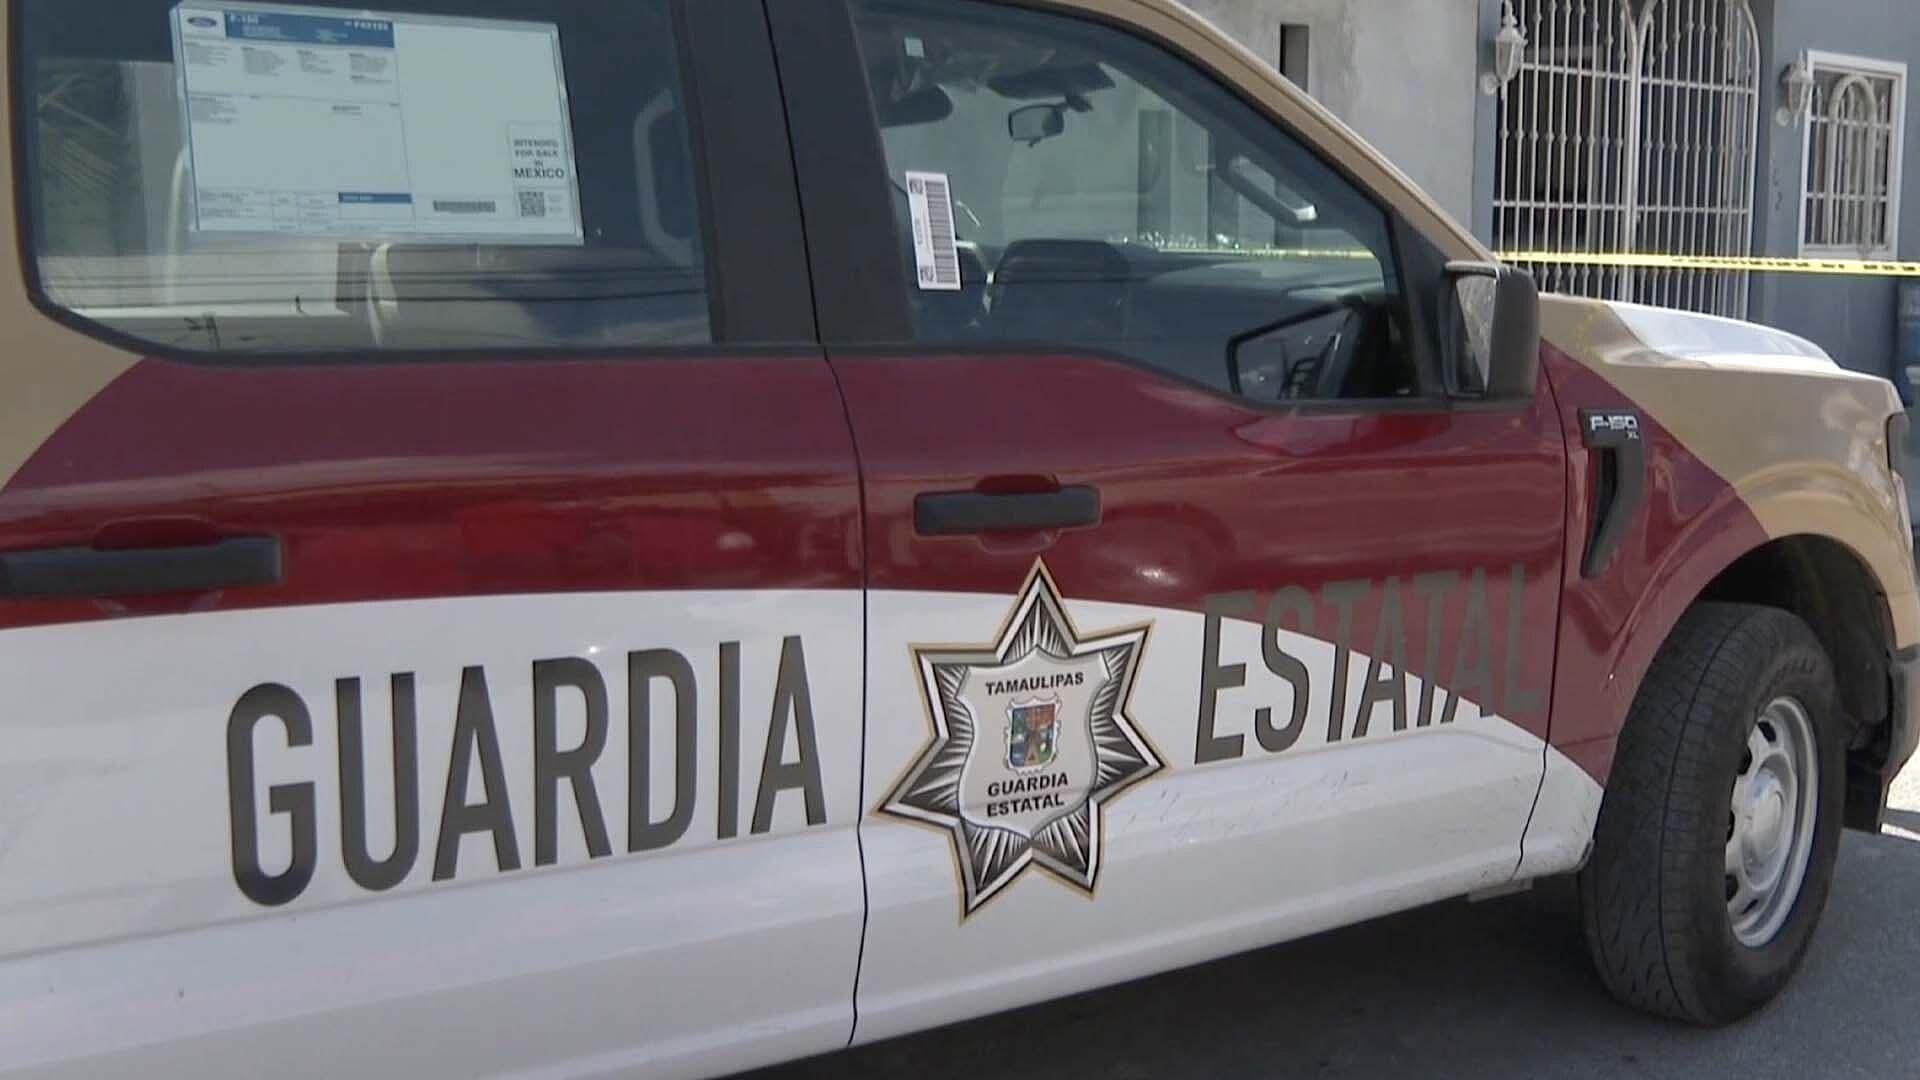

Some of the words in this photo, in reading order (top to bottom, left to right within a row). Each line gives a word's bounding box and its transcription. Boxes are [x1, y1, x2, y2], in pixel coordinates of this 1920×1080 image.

[513, 167, 565, 179] MEXICO
[985, 671, 1085, 696] TAMAULIPAS
[227, 635, 827, 906] GUARDIA
[1195, 562, 1544, 764] ESTATAL
[987, 772, 1069, 797] GUARDIA
[986, 794, 1065, 817] ESTATAL
